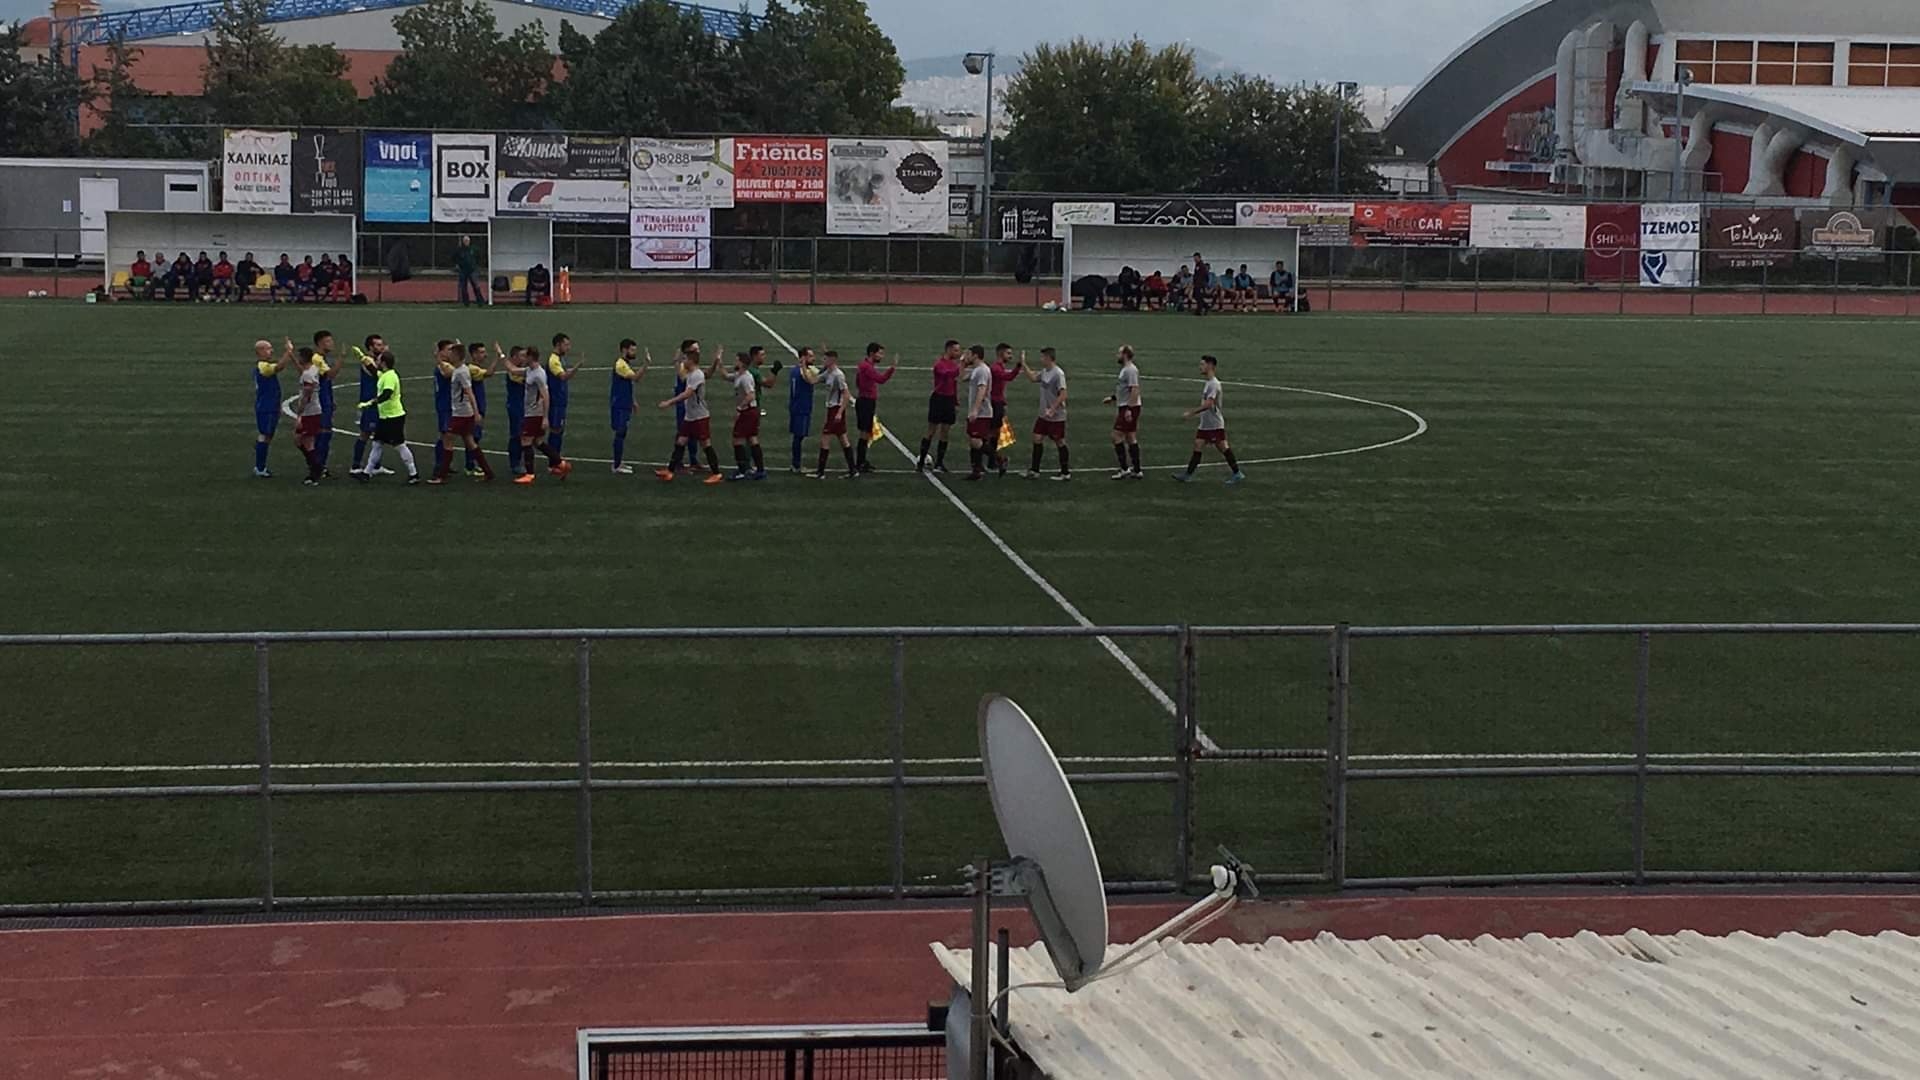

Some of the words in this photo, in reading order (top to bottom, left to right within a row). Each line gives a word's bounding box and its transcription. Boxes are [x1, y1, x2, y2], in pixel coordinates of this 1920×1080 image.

[227, 152, 289, 166] ΧΑΛΙΚΙΑΣ
[736, 143, 824, 161] Friends
[234, 171, 281, 183] ΟΠΤΙΚΑ
[447, 162, 490, 178] BOX
[686, 174, 702, 186] 24
[736, 179, 772, 189] DELIVERY
[1642, 221, 1699, 235] ΤΖΕΜΟΣ
